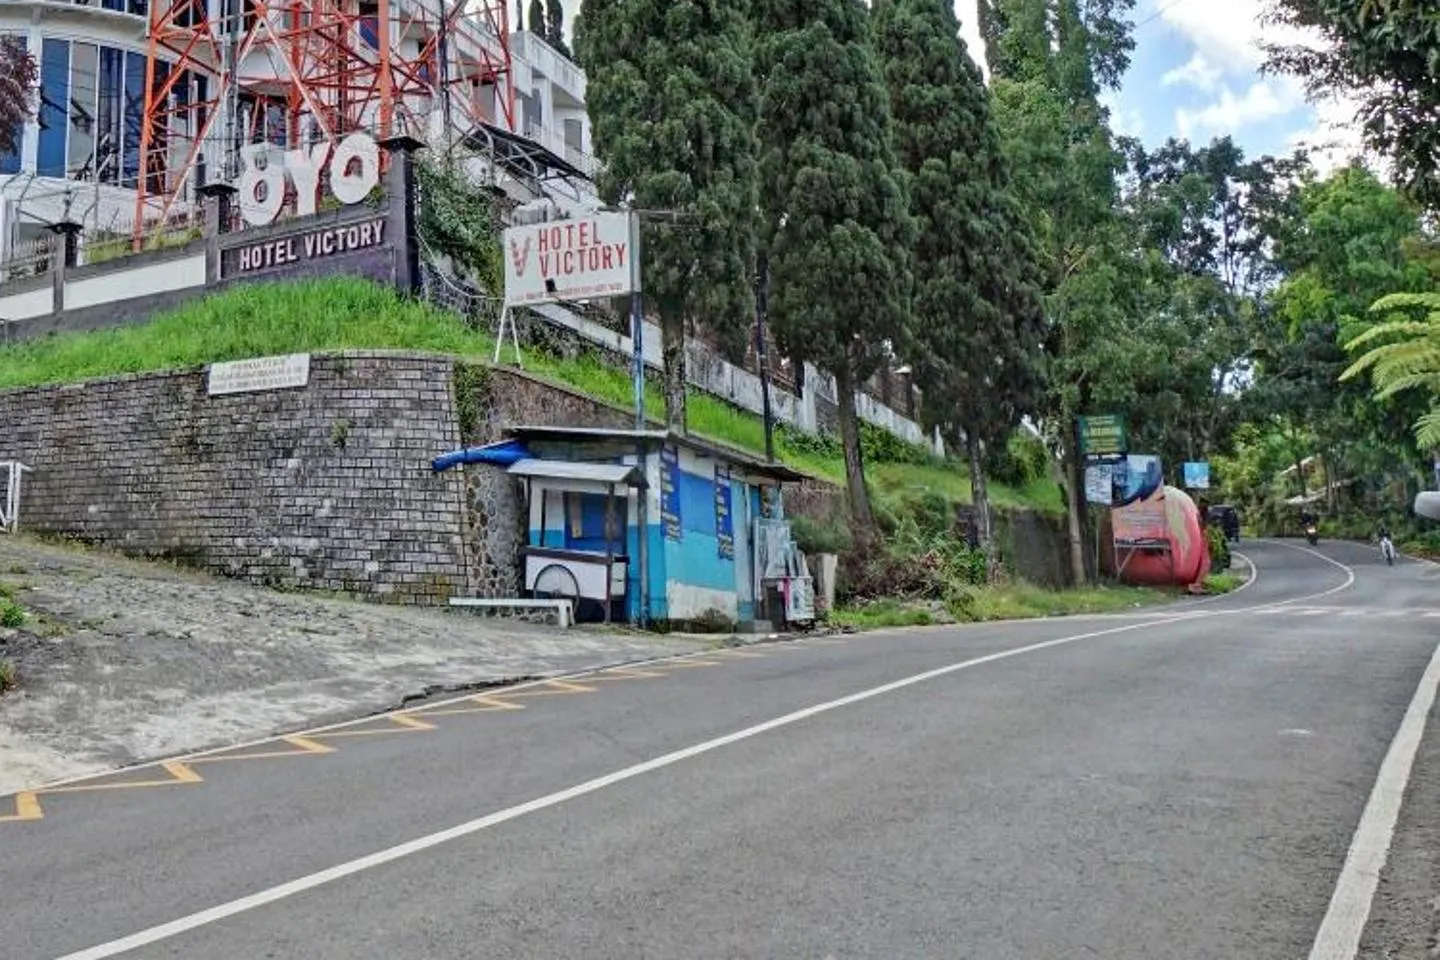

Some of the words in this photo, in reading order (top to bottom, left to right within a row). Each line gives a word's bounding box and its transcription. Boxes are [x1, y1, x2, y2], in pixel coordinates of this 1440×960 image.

[239, 132, 381, 226] OYO
[239, 238, 298, 271] HOTEL
[304, 219, 385, 258] VICTORY
[538, 220, 601, 253] HOTEL
[539, 243, 626, 277] VICTORY
